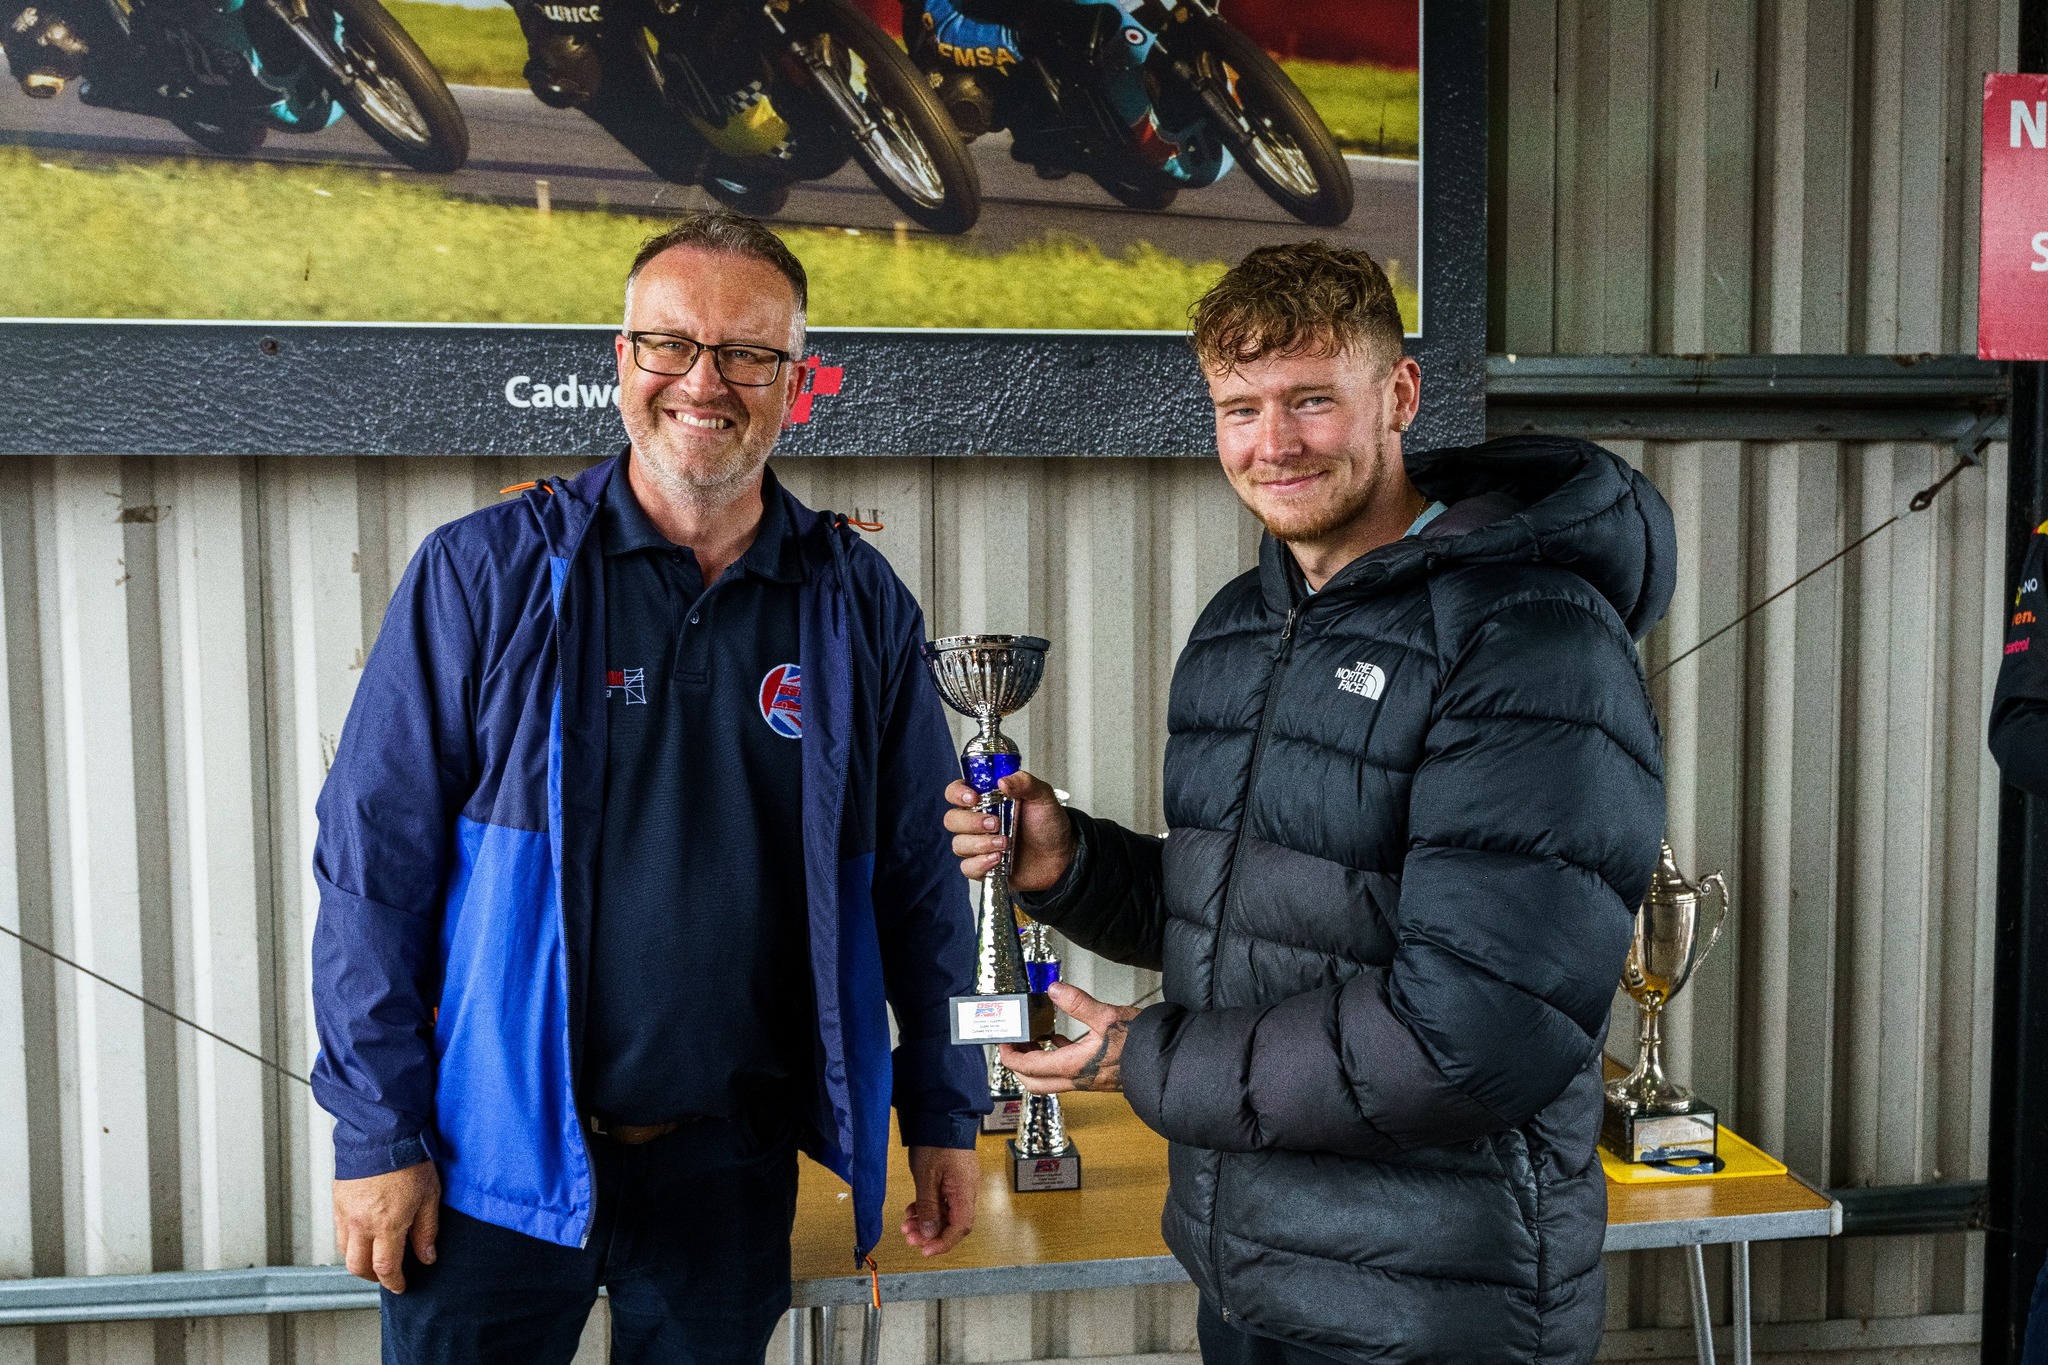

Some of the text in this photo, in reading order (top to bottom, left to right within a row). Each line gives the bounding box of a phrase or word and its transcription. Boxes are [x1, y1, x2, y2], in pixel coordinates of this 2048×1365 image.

[1354, 661, 1374, 674] THE
[1334, 667, 1368, 684] NORTH
[1337, 680, 1364, 694] FACE
